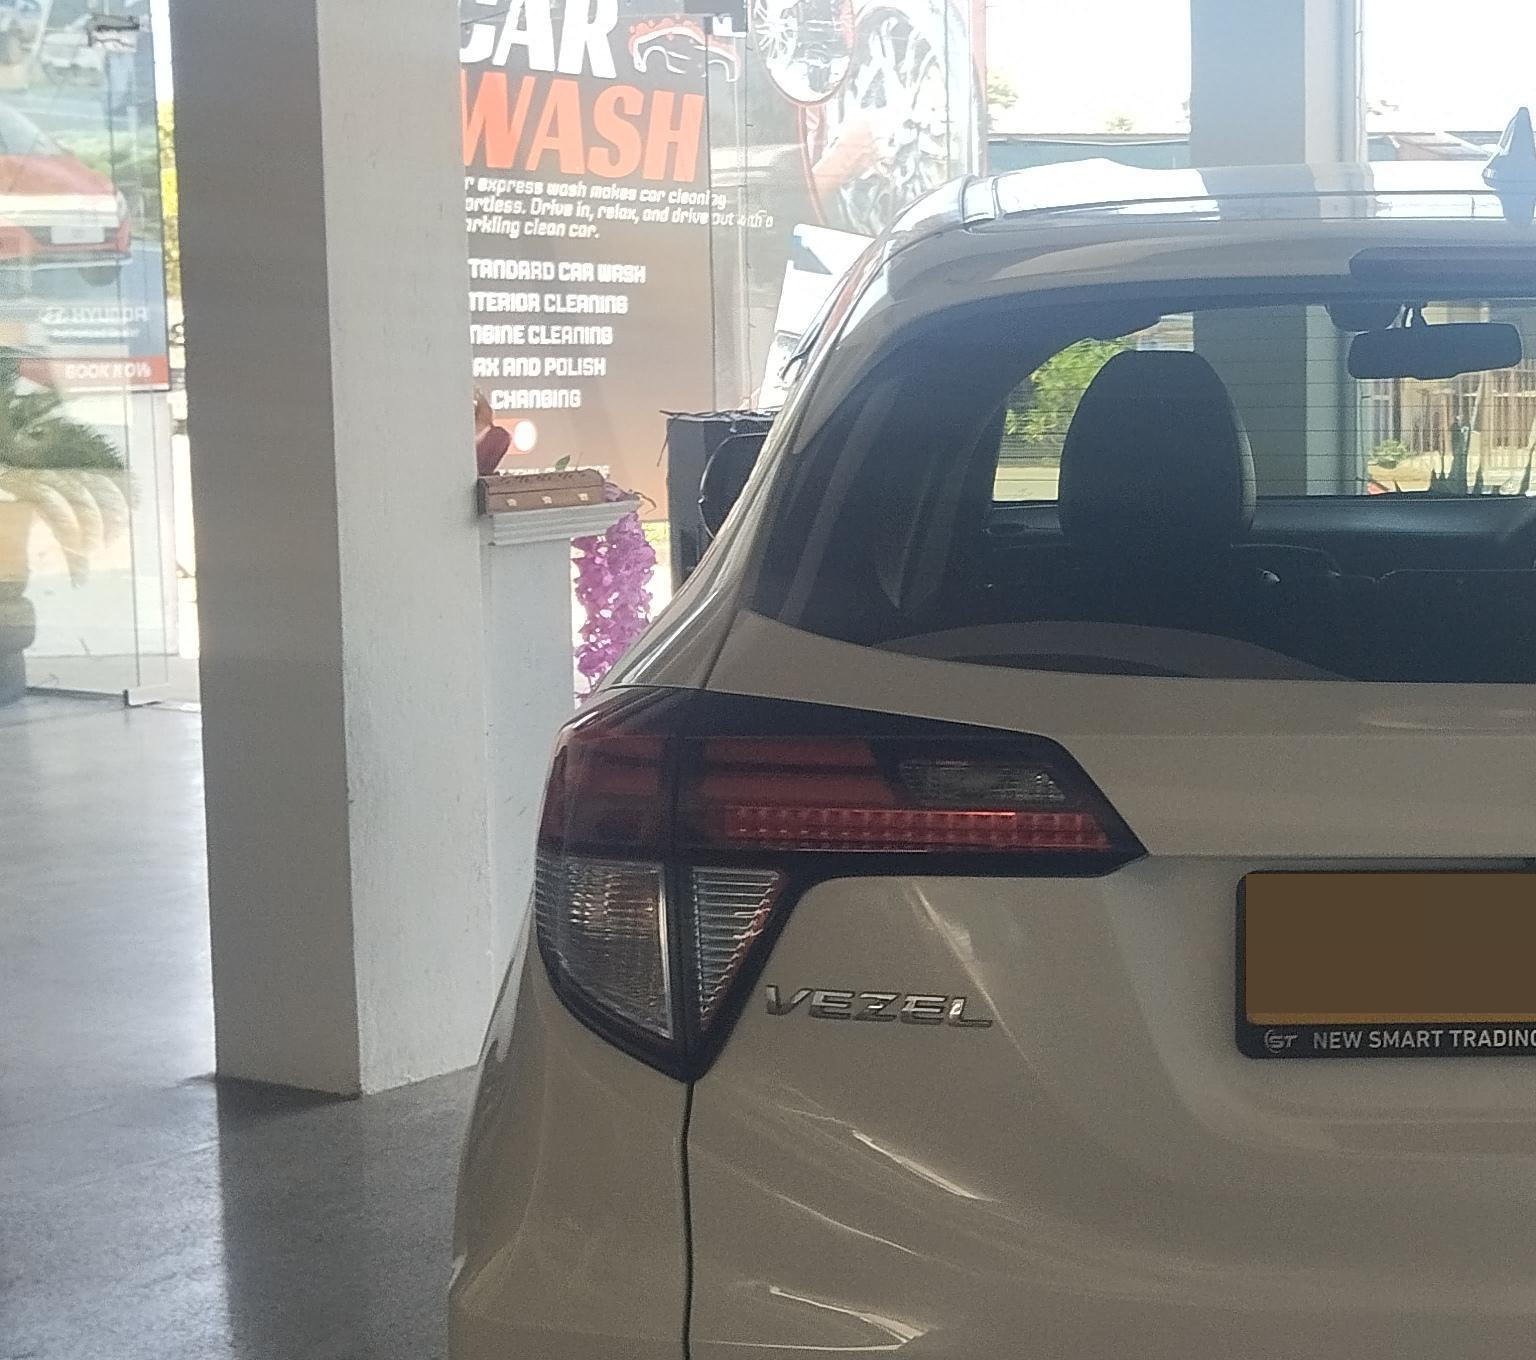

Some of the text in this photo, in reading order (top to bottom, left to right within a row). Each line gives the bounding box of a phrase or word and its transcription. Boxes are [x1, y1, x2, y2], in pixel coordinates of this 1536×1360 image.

[461, 69, 705, 182] WASH
[477, 178, 543, 197] express
[547, 180, 587, 199] wash
[590, 184, 636, 201] makes
[640, 189, 666, 203] car
[465, 194, 526, 216] ortless.
[530, 198, 573, 217] Drive
[597, 204, 640, 225] relax,
[642, 207, 669, 224] and
[671, 208, 709, 226] drive
[524, 219, 565, 238] clean
[568, 223, 600, 239] car.
[468, 257, 646, 284] TANDARD CAR WASH
[468, 292, 628, 314] TERIOR CLEANING
[470, 324, 613, 345] NGINE CLEANING
[473, 356, 606, 377] AX AND POLISH
[490, 390, 582, 410] CHANGING
[765, 984, 992, 1028] VEZEL
[1313, 1030, 1363, 1049] NEW
[1368, 1030, 1445, 1049] SMART
